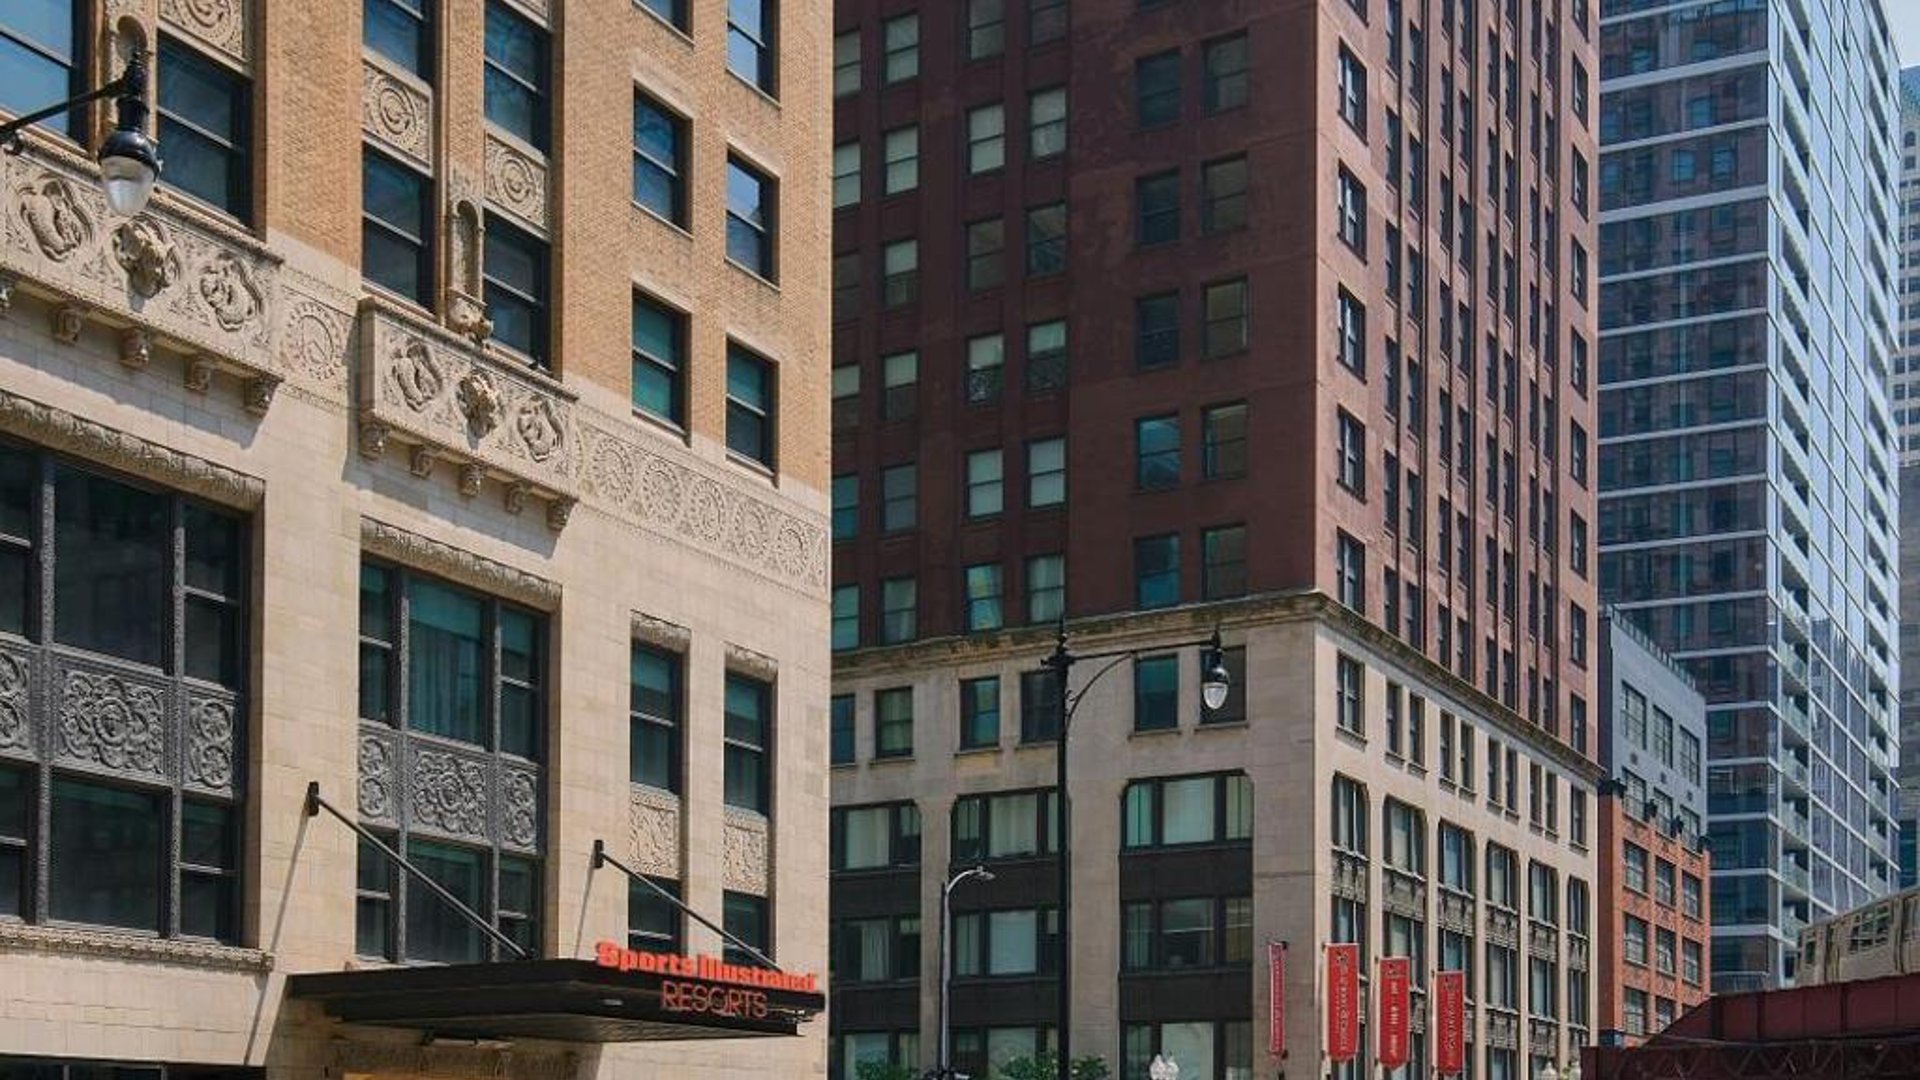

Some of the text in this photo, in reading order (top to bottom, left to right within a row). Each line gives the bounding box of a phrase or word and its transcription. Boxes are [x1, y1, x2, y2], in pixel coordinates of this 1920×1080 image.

[596, 940, 816, 991] Sports Illustrated
[661, 980, 768, 1018] RESORTS
